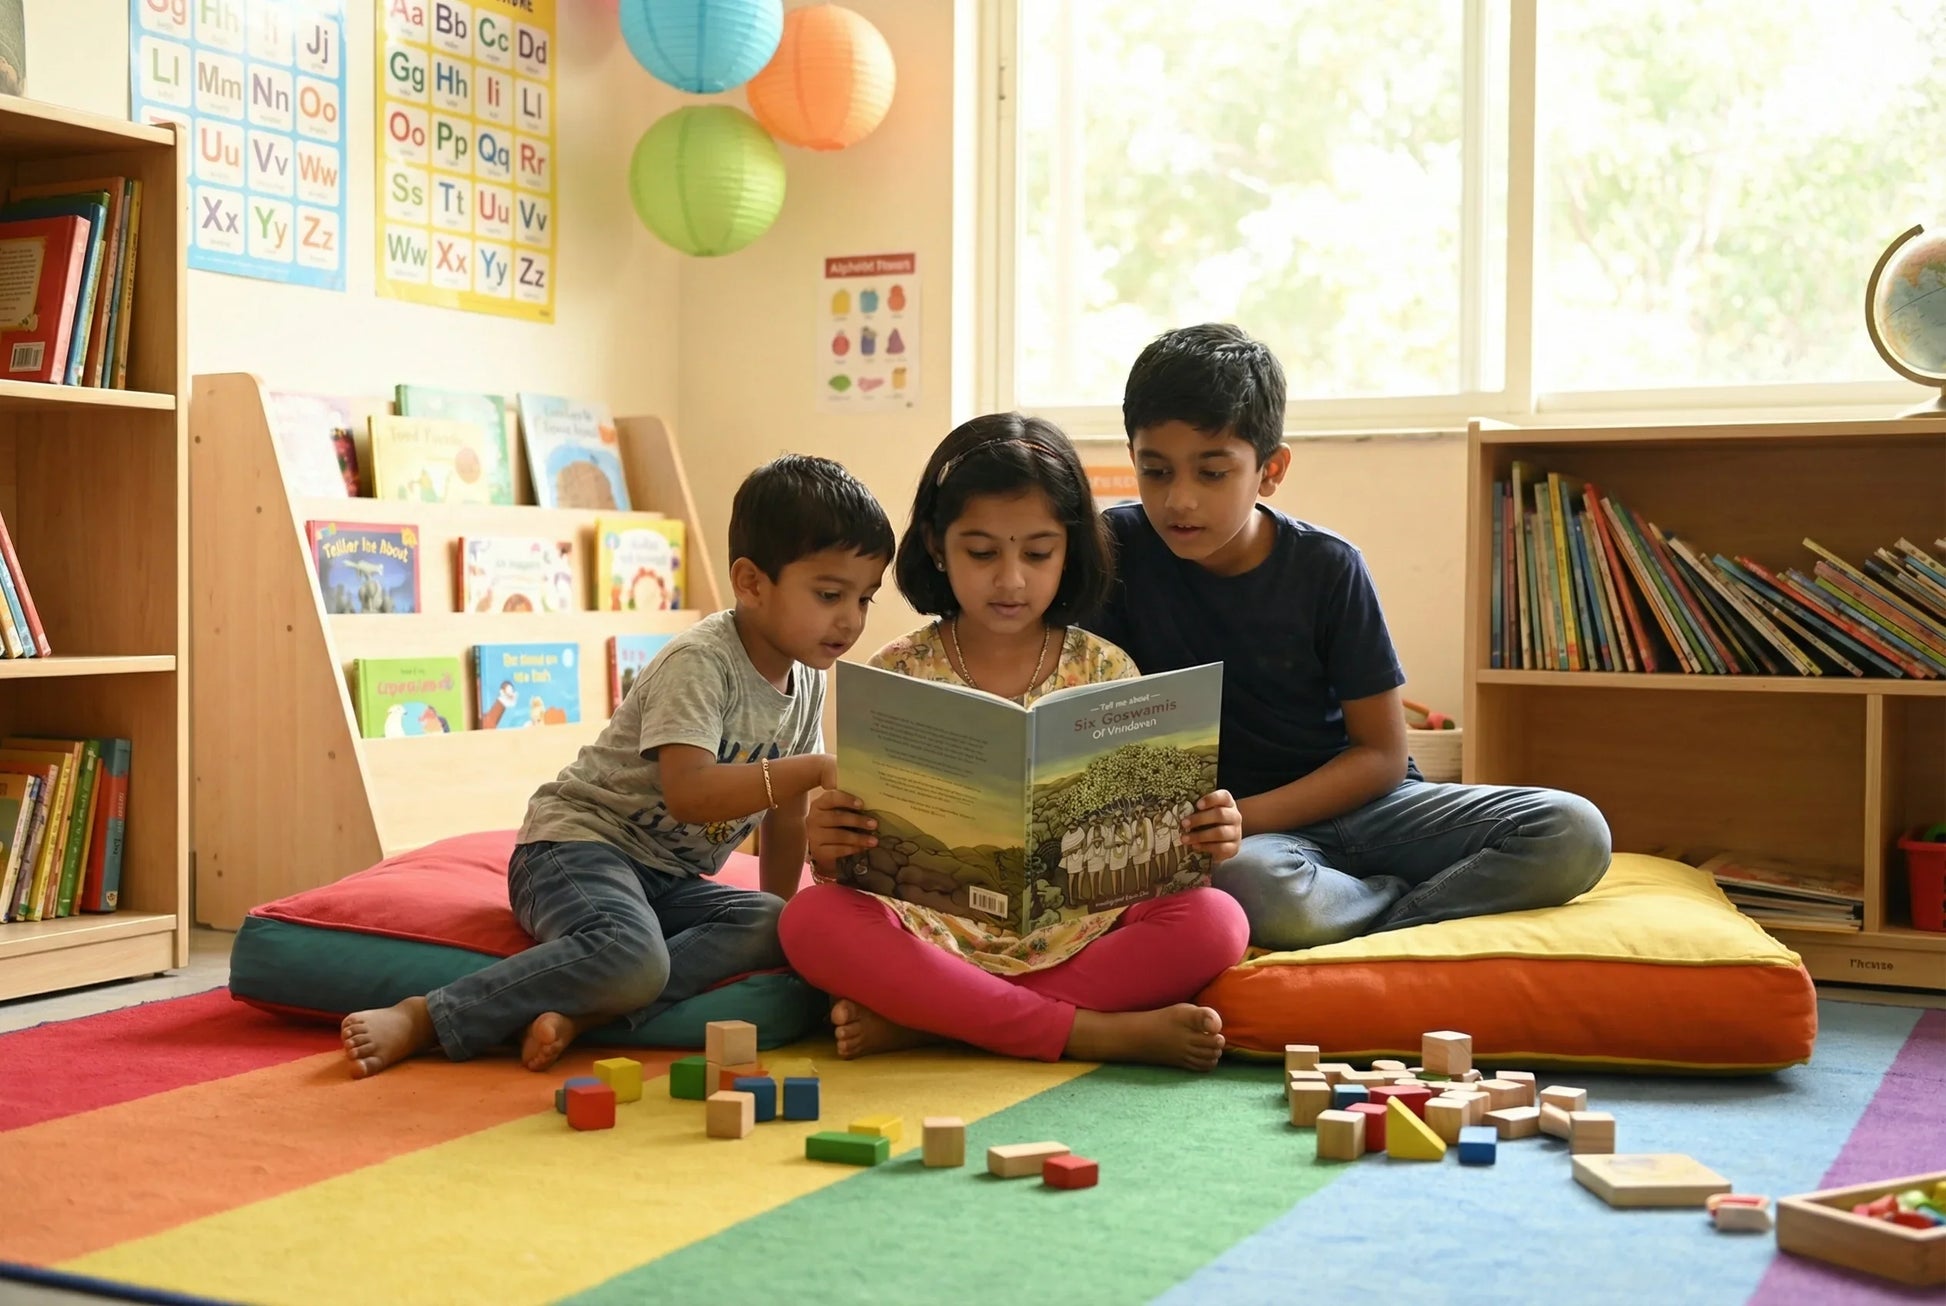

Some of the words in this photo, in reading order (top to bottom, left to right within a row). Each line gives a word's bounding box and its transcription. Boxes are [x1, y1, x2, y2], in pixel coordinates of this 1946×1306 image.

[306, 25, 329, 64] Jj
[390, 0, 424, 26] Aa
[436, 3, 467, 39] Bb
[479, 18, 509, 52] Cc
[519, 29, 547, 64] Dd
[198, 61, 242, 101] Mm
[253, 72, 289, 113] Nn
[299, 86, 337, 123] Oo
[390, 51, 424, 93] Gg
[437, 62, 467, 98] Hh
[487, 76, 500, 108] Ii
[201, 127, 239, 168] Uu
[253, 138, 289, 176] Vv
[298, 151, 338, 188] Ww
[390, 111, 425, 146] Oo
[438, 121, 467, 160] Pp
[478, 133, 509, 174] Qq
[520, 143, 546, 175] Rr
[202, 196, 240, 234] Xx
[254, 205, 288, 249] Yy
[302, 215, 335, 251] Zz
[392, 172, 424, 206] Ss
[438, 181, 464, 215] Tt
[480, 190, 509, 225] Uu
[519, 199, 547, 232] Vv
[388, 233, 428, 267] Ww
[436, 240, 468, 274] Xx
[480, 248, 508, 287] Yy
[519, 257, 545, 288] Zz
[1074, 717, 1096, 732] Six
[1102, 699, 1177, 725] Goswamis
[1099, 701, 1114, 711] Tell
[1115, 699, 1128, 709] me
[1129, 693, 1150, 705] about
